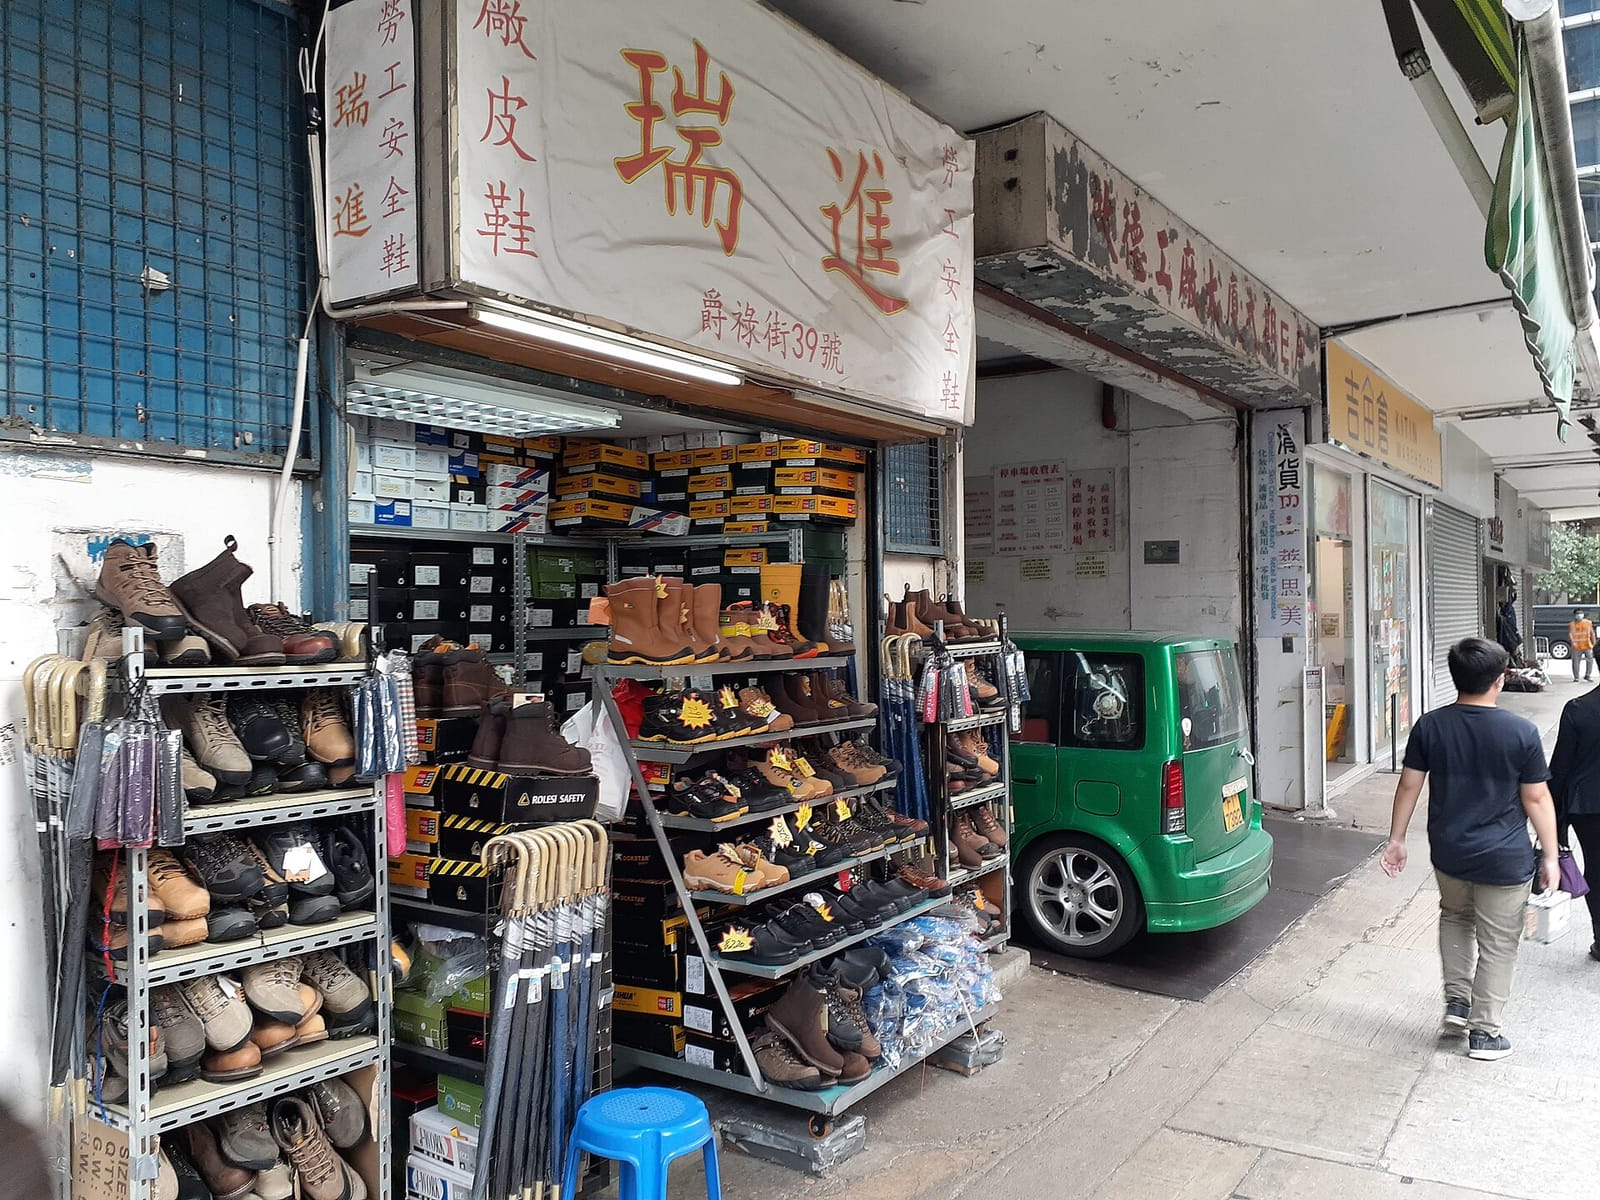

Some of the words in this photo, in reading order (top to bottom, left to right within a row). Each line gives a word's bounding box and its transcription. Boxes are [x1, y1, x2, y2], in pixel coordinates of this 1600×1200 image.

[332, 72, 372, 238] 瑞進
[377, 1, 411, 278] 勞工安全鞋
[613, 39, 910, 315] 瑞進
[700, 287, 845, 375] 爵祿街39號
[939, 144, 962, 412] 勞工安全鞋
[559, 793, 586, 804] SAFETY
[91, 1136, 102, 1190] G.W.:
[103, 1141, 116, 1196] Q'TY:
